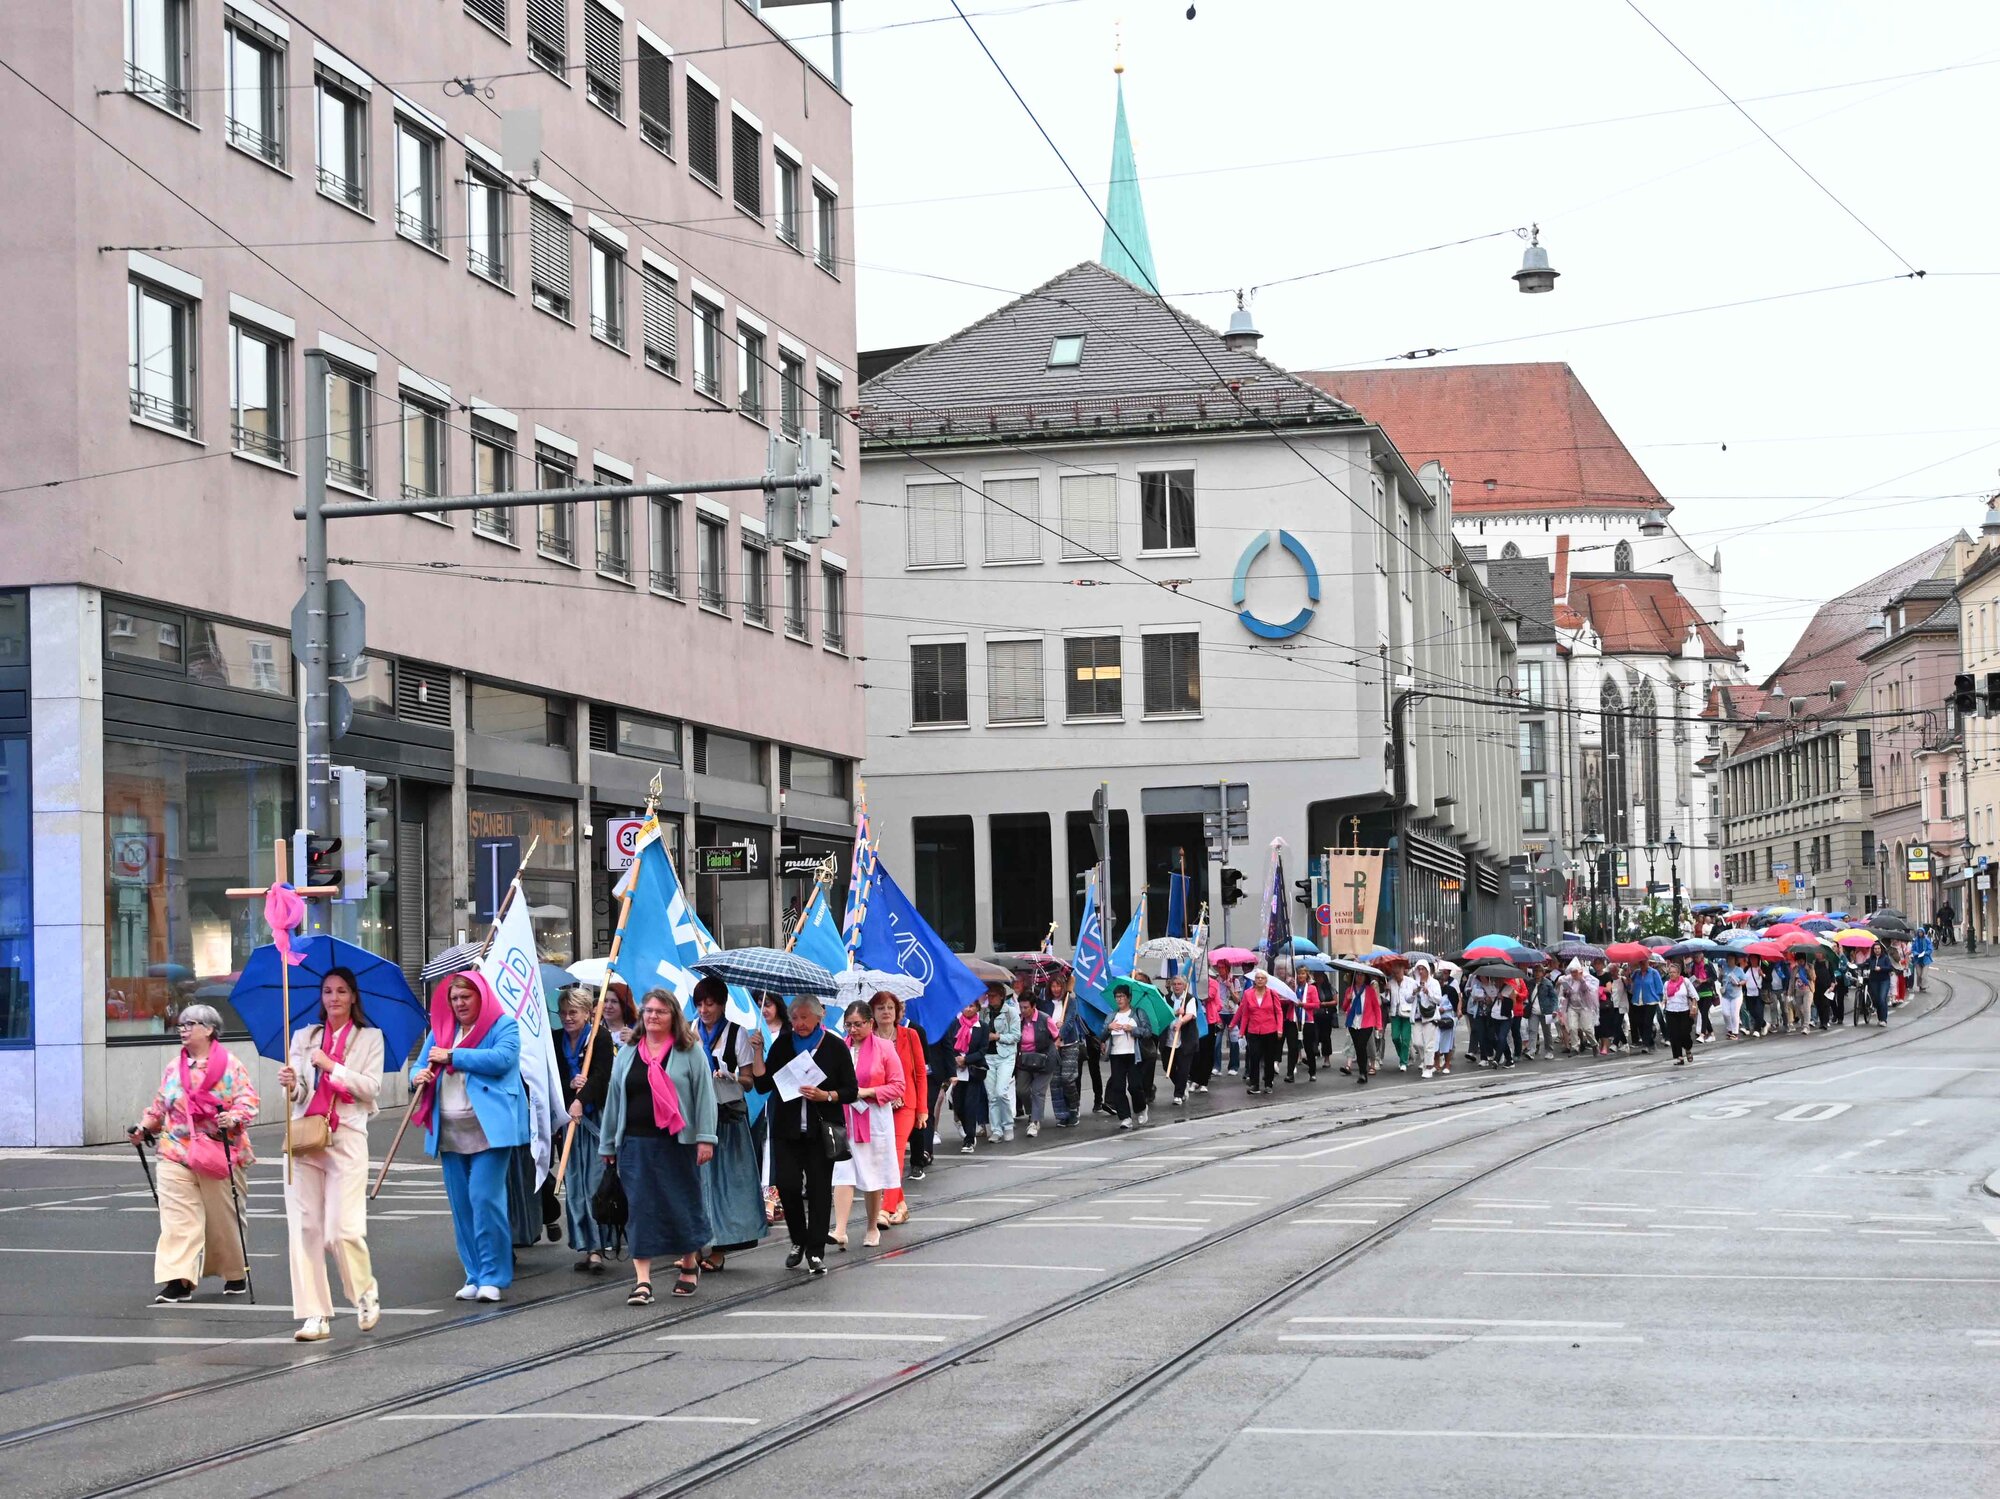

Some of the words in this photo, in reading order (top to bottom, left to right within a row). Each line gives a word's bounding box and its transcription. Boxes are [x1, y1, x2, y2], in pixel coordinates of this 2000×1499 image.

[620, 858, 635, 867] ZO
[706, 854, 731, 867] Falafel
[1688, 1100, 1853, 1122] 30
